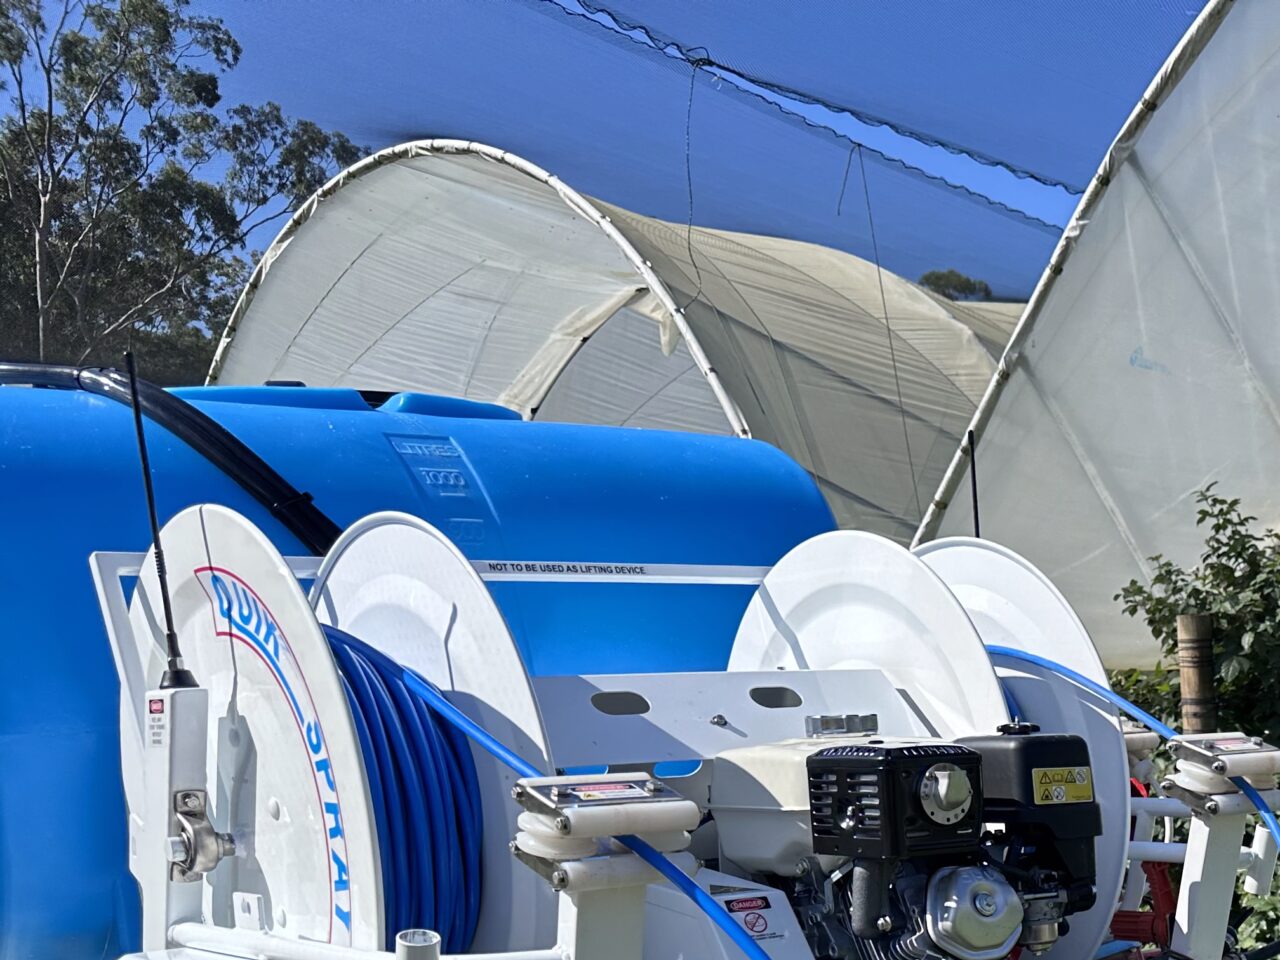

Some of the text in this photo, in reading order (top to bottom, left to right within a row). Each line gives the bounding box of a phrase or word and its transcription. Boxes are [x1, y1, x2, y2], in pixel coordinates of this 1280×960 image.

[421, 470, 469, 486] 1000
[488, 563, 645, 574] NOT TO BE USED AS LIFTING DEVICE
[211, 574, 281, 663] QUIK
[305, 719, 351, 933] SPRAY
